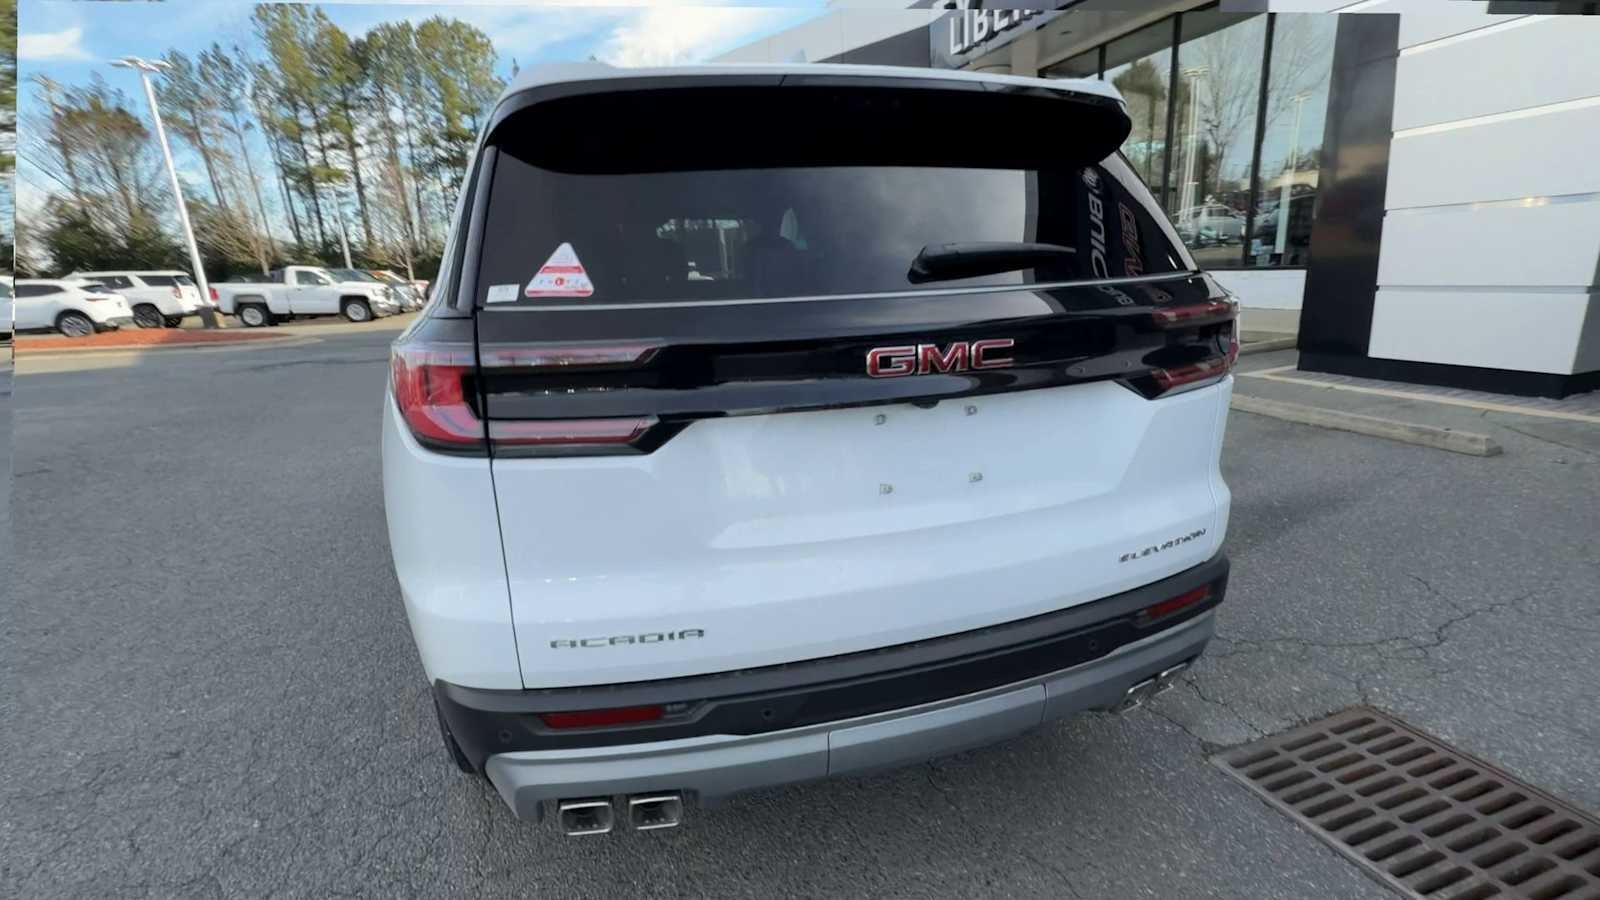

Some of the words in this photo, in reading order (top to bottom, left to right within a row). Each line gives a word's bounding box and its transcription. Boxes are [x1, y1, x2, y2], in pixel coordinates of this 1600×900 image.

[866, 338, 1014, 378] GMC
[1118, 528, 1207, 563] ELEVATION
[549, 628, 705, 649] ACADIA
